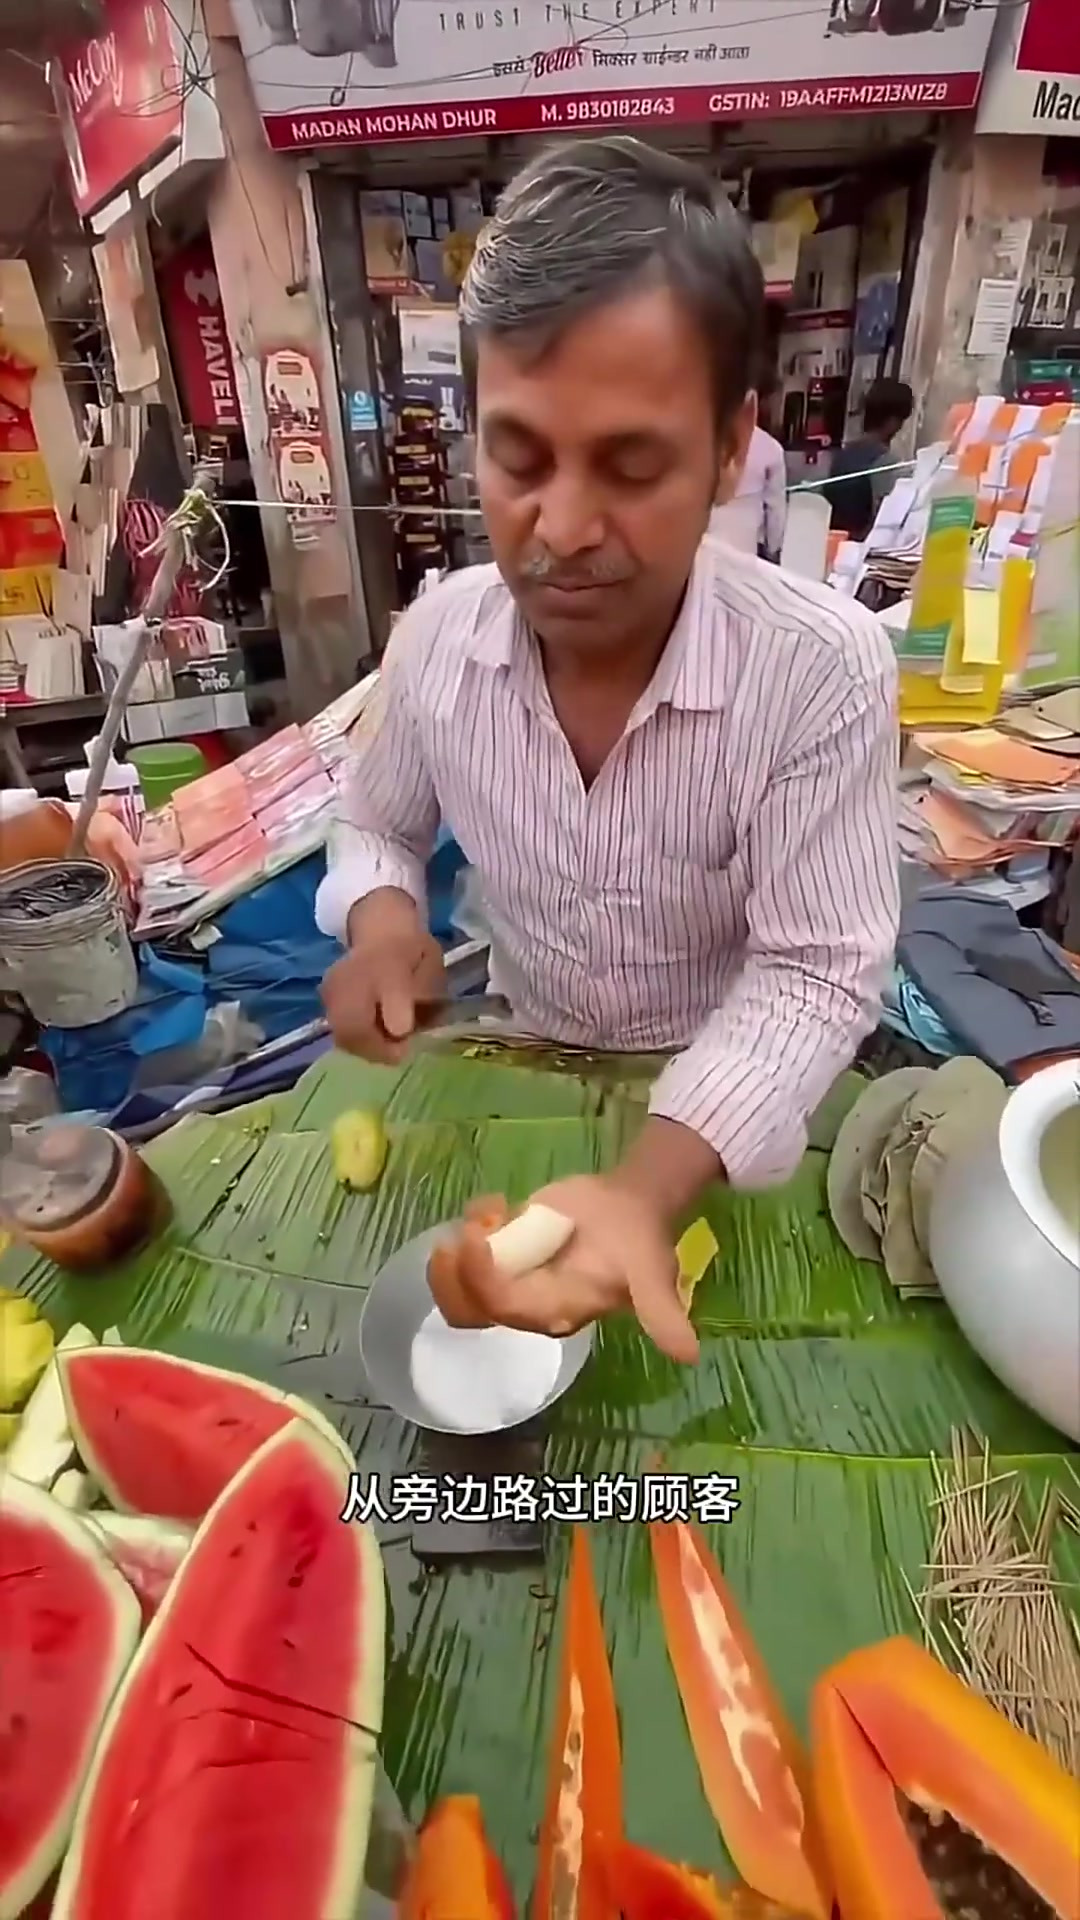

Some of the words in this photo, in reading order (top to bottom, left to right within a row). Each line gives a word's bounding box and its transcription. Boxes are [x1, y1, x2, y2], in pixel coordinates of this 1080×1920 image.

[439, 7, 520, 31] TRUST
[69, 32, 124, 113] McCoy
[291, 121, 363, 141] MADAN
[366, 113, 438, 134] MOHAN
[442, 107, 497, 129] DHUR
[540, 103, 562, 122] M.
[566, 97, 675, 120] 9830182843
[708, 91, 770, 112] GSTIN:
